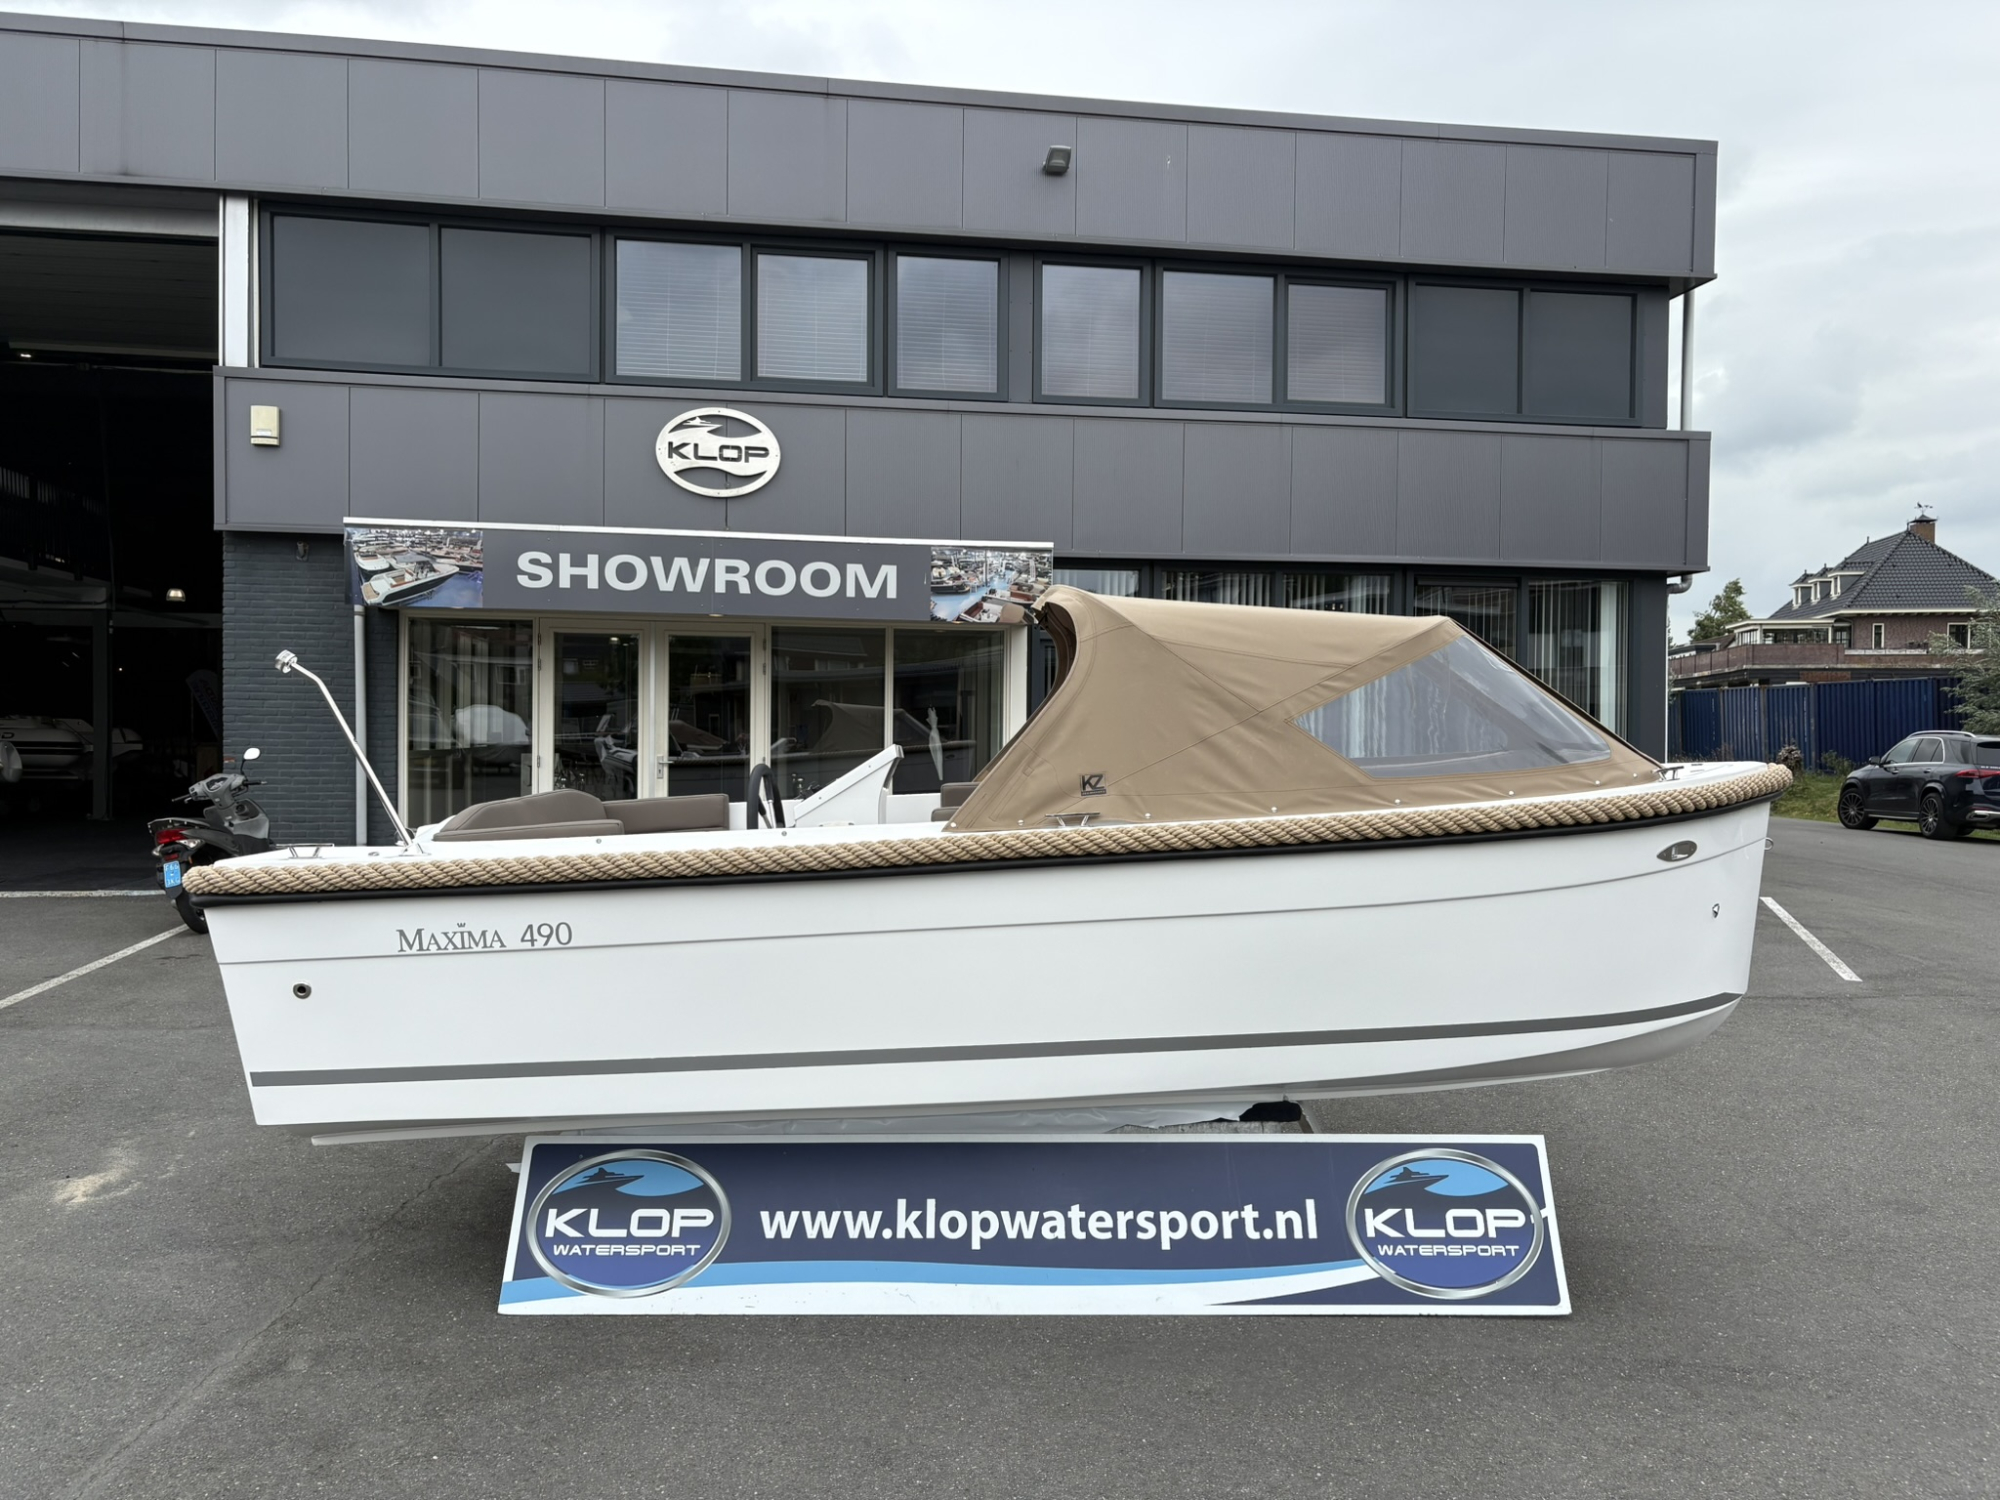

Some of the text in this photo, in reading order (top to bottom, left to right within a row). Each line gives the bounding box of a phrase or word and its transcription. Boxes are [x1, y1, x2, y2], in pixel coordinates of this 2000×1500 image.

[668, 441, 770, 463] KLOP
[516, 551, 898, 599] SHOWROOM
[1082, 774, 1105, 791] KZ
[396, 922, 573, 953] MAXIMA 490
[545, 1208, 714, 1238] KLOP
[759, 1198, 1318, 1250] www.klopwatersport.nl
[1363, 1208, 1526, 1238] KLOP
[552, 1244, 702, 1256] WATERSPORT
[1377, 1244, 1520, 1257] WATERSPORT
